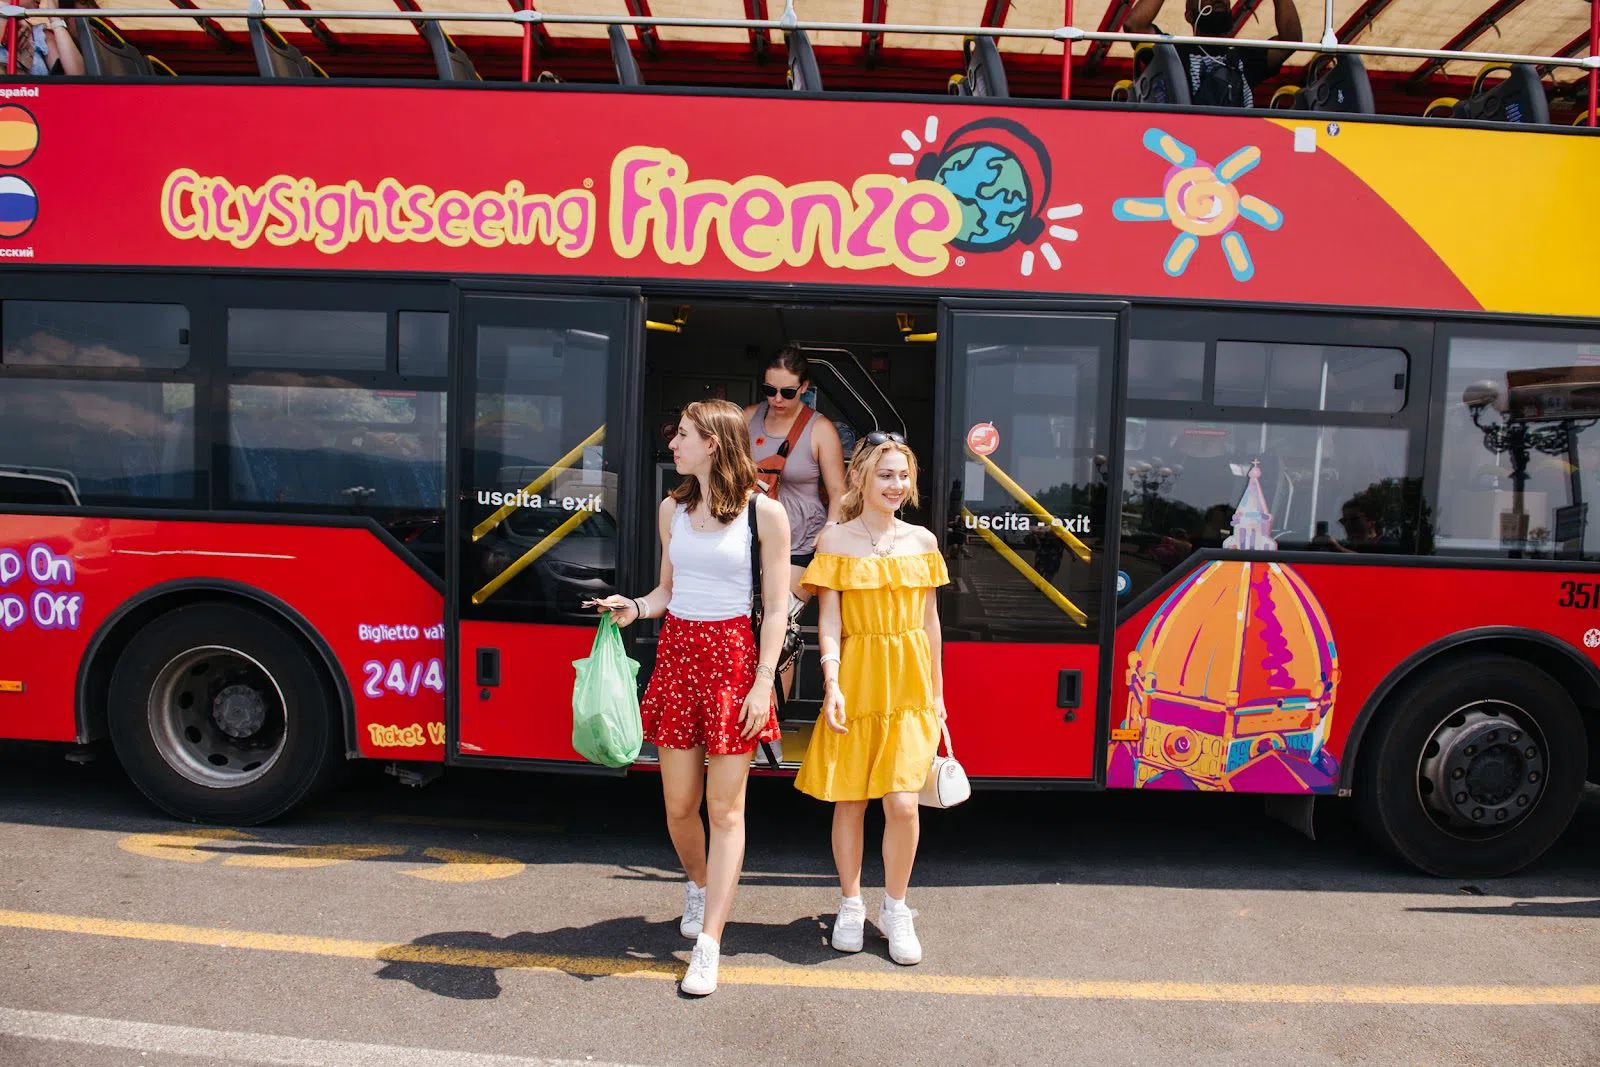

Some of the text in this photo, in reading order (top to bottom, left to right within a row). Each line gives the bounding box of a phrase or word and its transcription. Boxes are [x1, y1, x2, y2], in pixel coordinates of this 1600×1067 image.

[477, 489, 542, 509] uscita
[562, 493, 602, 513] exit
[964, 512, 1030, 531] uscita
[1050, 514, 1091, 533] exit
[27, 543, 75, 586] On
[30, 588, 84, 630] Off
[359, 624, 419, 643] Biglietto
[368, 722, 426, 747] Ticket
